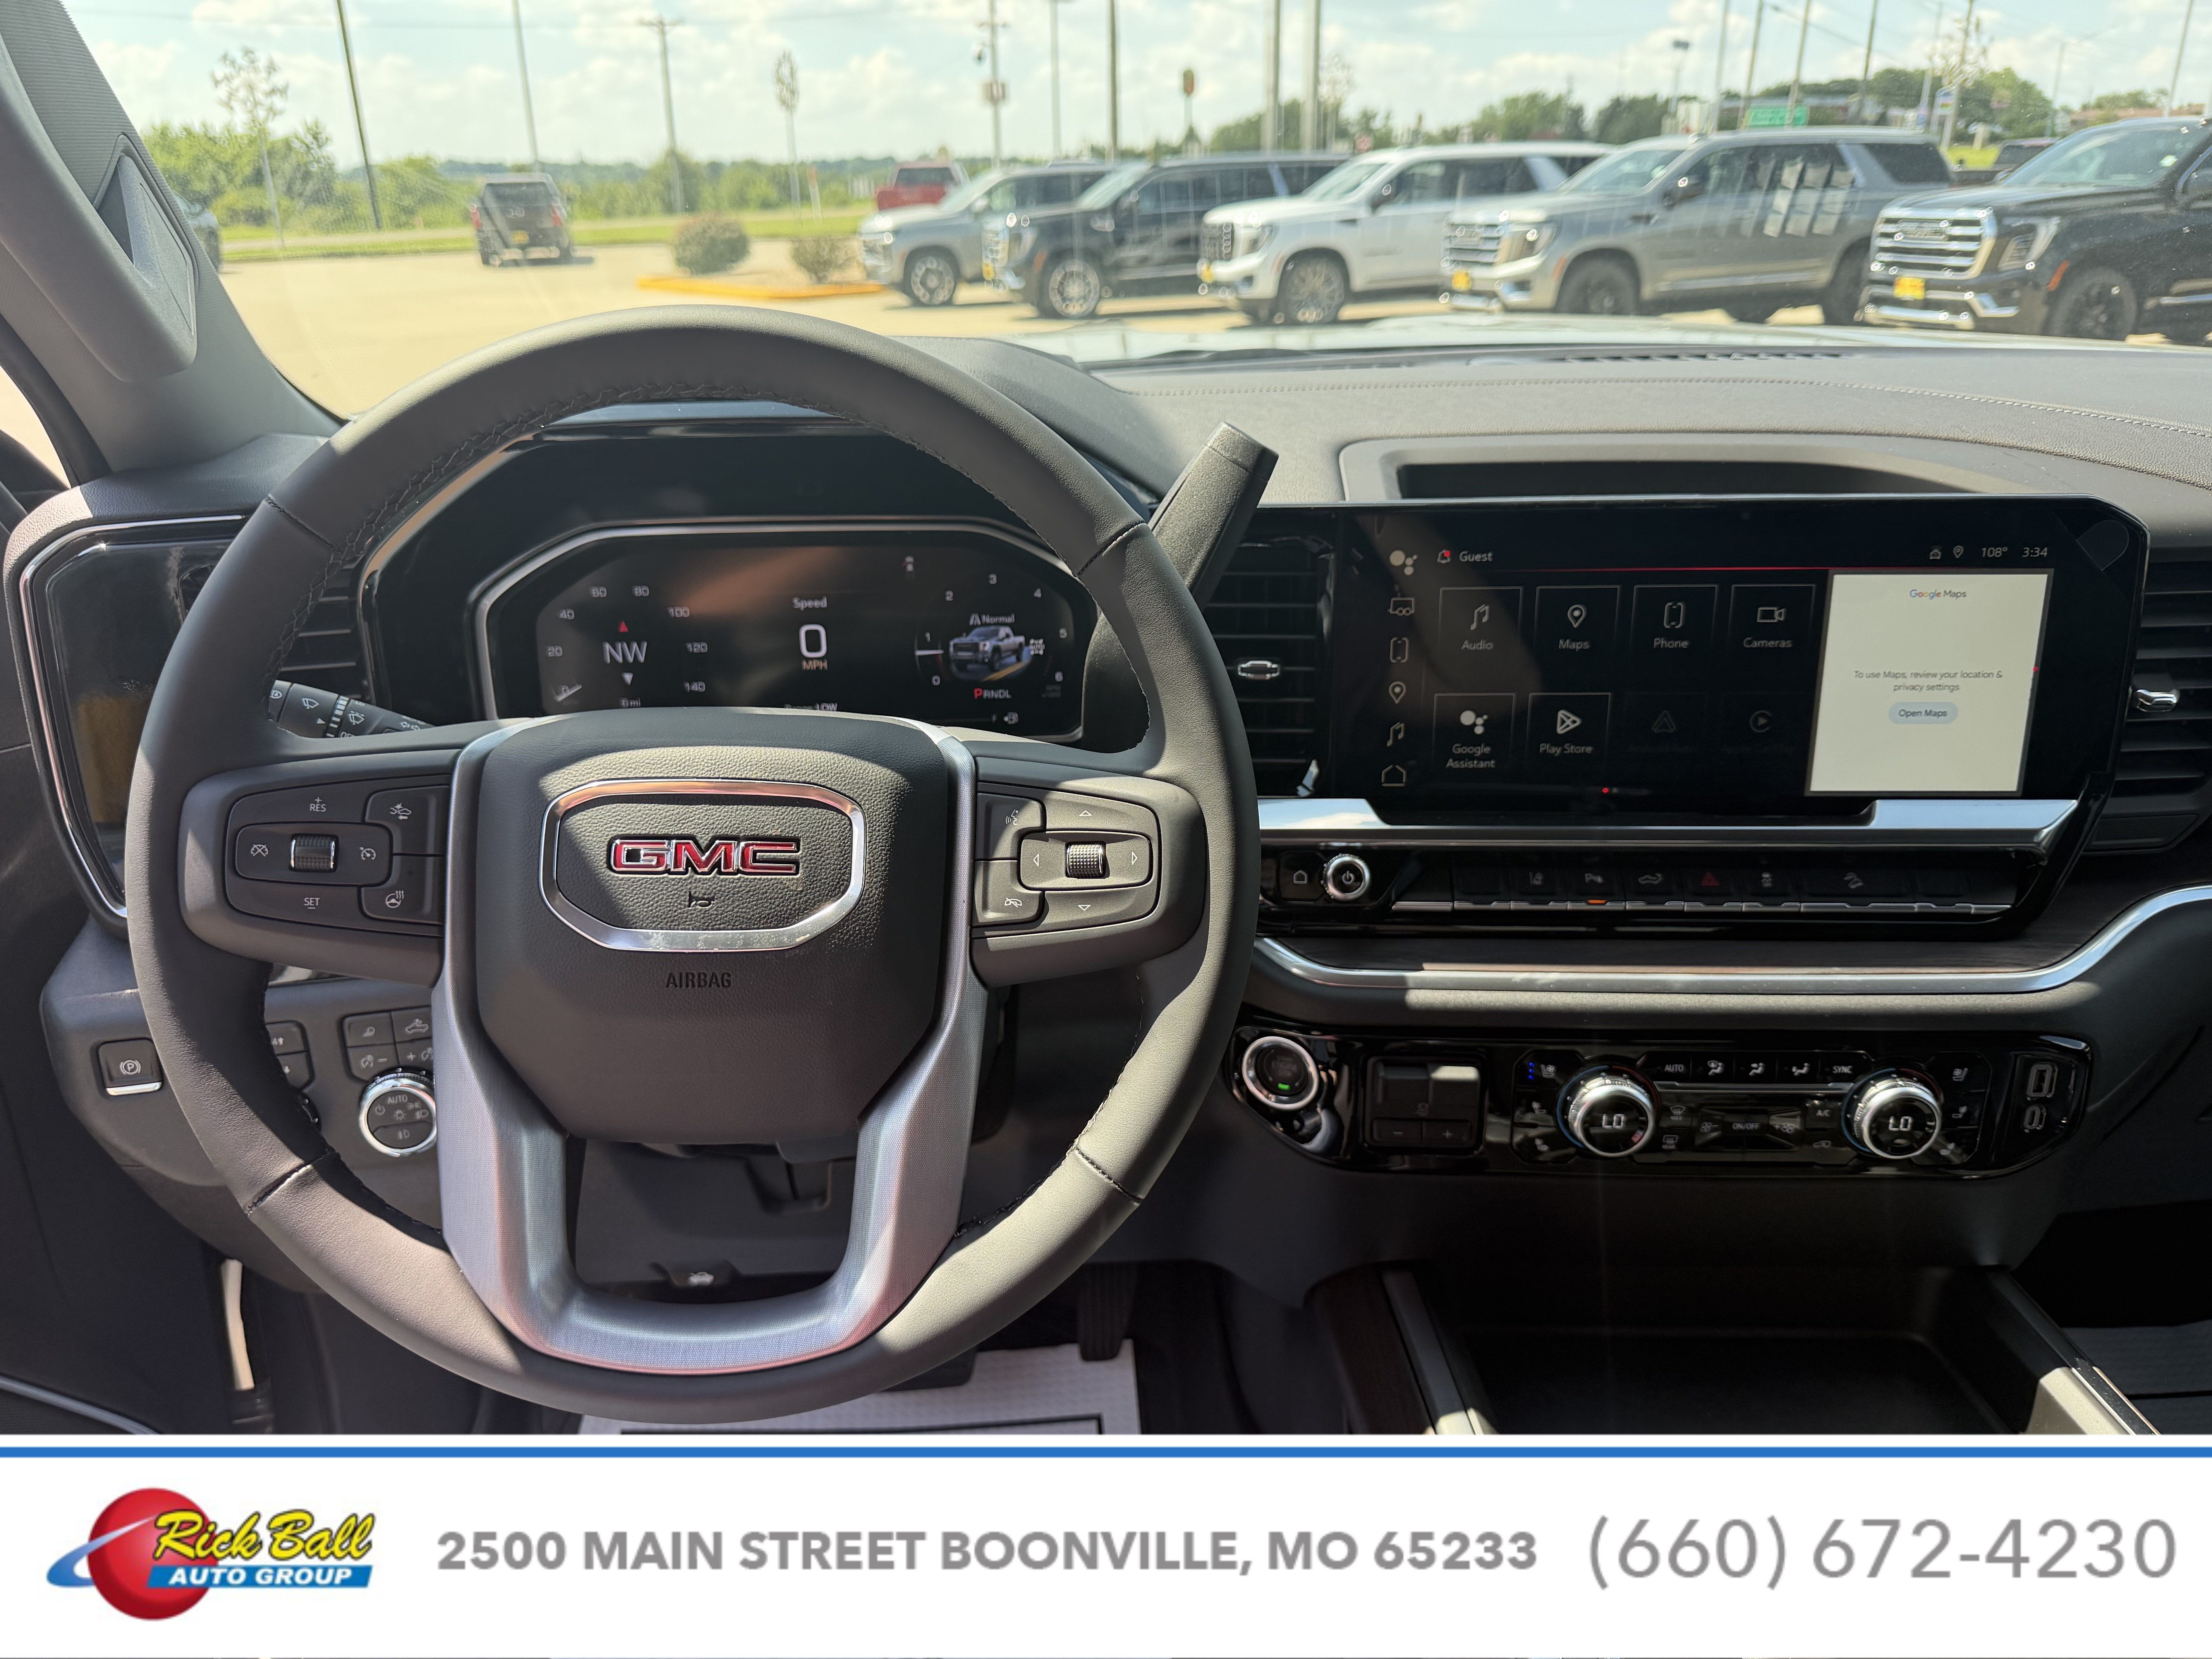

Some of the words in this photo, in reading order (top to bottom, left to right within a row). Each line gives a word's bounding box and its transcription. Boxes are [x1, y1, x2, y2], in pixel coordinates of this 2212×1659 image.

[1459, 550, 1493, 562] Guest
[1982, 546, 2008, 557] 108°
[2021, 547, 2048, 557] 3:34
[632, 585, 649, 596] 80
[945, 590, 953, 601] 2
[1034, 588, 1042, 598] 4
[1910, 589, 1941, 599] Google
[1943, 590, 1966, 599] Maps
[793, 596, 827, 611] Speed
[558, 608, 575, 620] 40
[668, 606, 690, 618] 100
[981, 613, 1015, 624] Normal
[799, 624, 827, 658] 0
[1461, 639, 1494, 650] Audio
[1558, 639, 1590, 651] Maps
[1653, 637, 1690, 649] Phone
[1743, 637, 1793, 648] Cameras
[546, 646, 563, 657] 20
[603, 641, 647, 664] NW
[685, 642, 708, 653] 120
[802, 659, 828, 670] MPH
[932, 675, 941, 685] 0
[1882, 671, 1907, 680] Maps,
[1910, 670, 1937, 678] review
[1938, 672, 1959, 680] your
[1960, 670, 1994, 678] location
[1996, 670, 2002, 678] &
[683, 681, 706, 692] 140
[1893, 682, 1924, 692] privacy
[1925, 682, 1960, 693] settings
[974, 687, 1012, 699] PRNDL
[1898, 709, 1922, 718] Open
[1924, 709, 1948, 718] Maps
[1452, 743, 1492, 756] Google
[1539, 743, 1562, 756] Play
[1563, 743, 1594, 754] Store
[1445, 757, 1496, 768] Assistant
[310, 804, 326, 812] RES
[610, 838, 800, 874] GMC
[304, 898, 320, 907] SET
[665, 971, 733, 989] AIRBAG
[1664, 1064, 1685, 1073] AUTO
[1832, 1065, 1853, 1074] SYNC
[388, 1094, 408, 1104] AUTO
